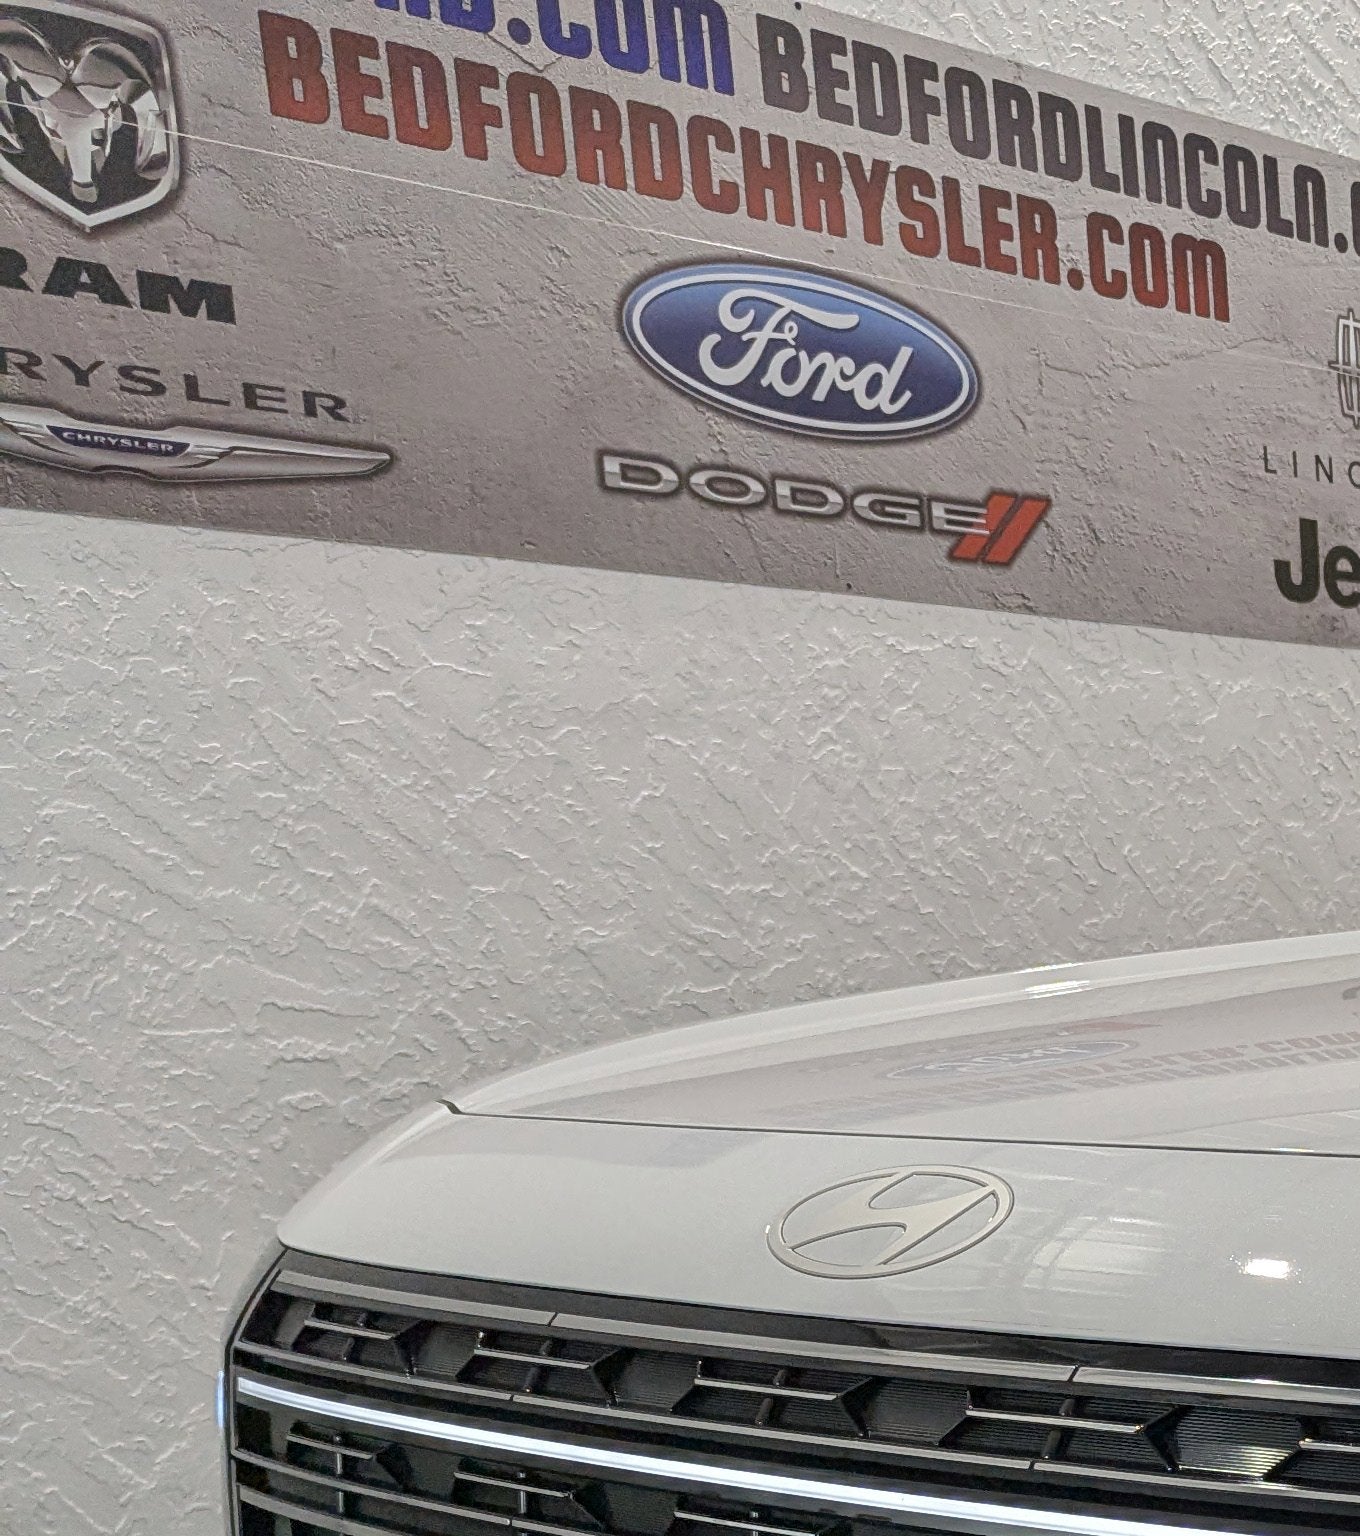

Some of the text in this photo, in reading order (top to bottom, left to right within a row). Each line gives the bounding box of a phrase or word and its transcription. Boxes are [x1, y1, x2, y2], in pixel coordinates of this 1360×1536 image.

[257, 8, 1231, 324] BEDFORDCHRYSLER.COM
[699, 288, 912, 415] Ford
[62, 430, 175, 454] CHRYSLER
[602, 455, 990, 536] DODGE
